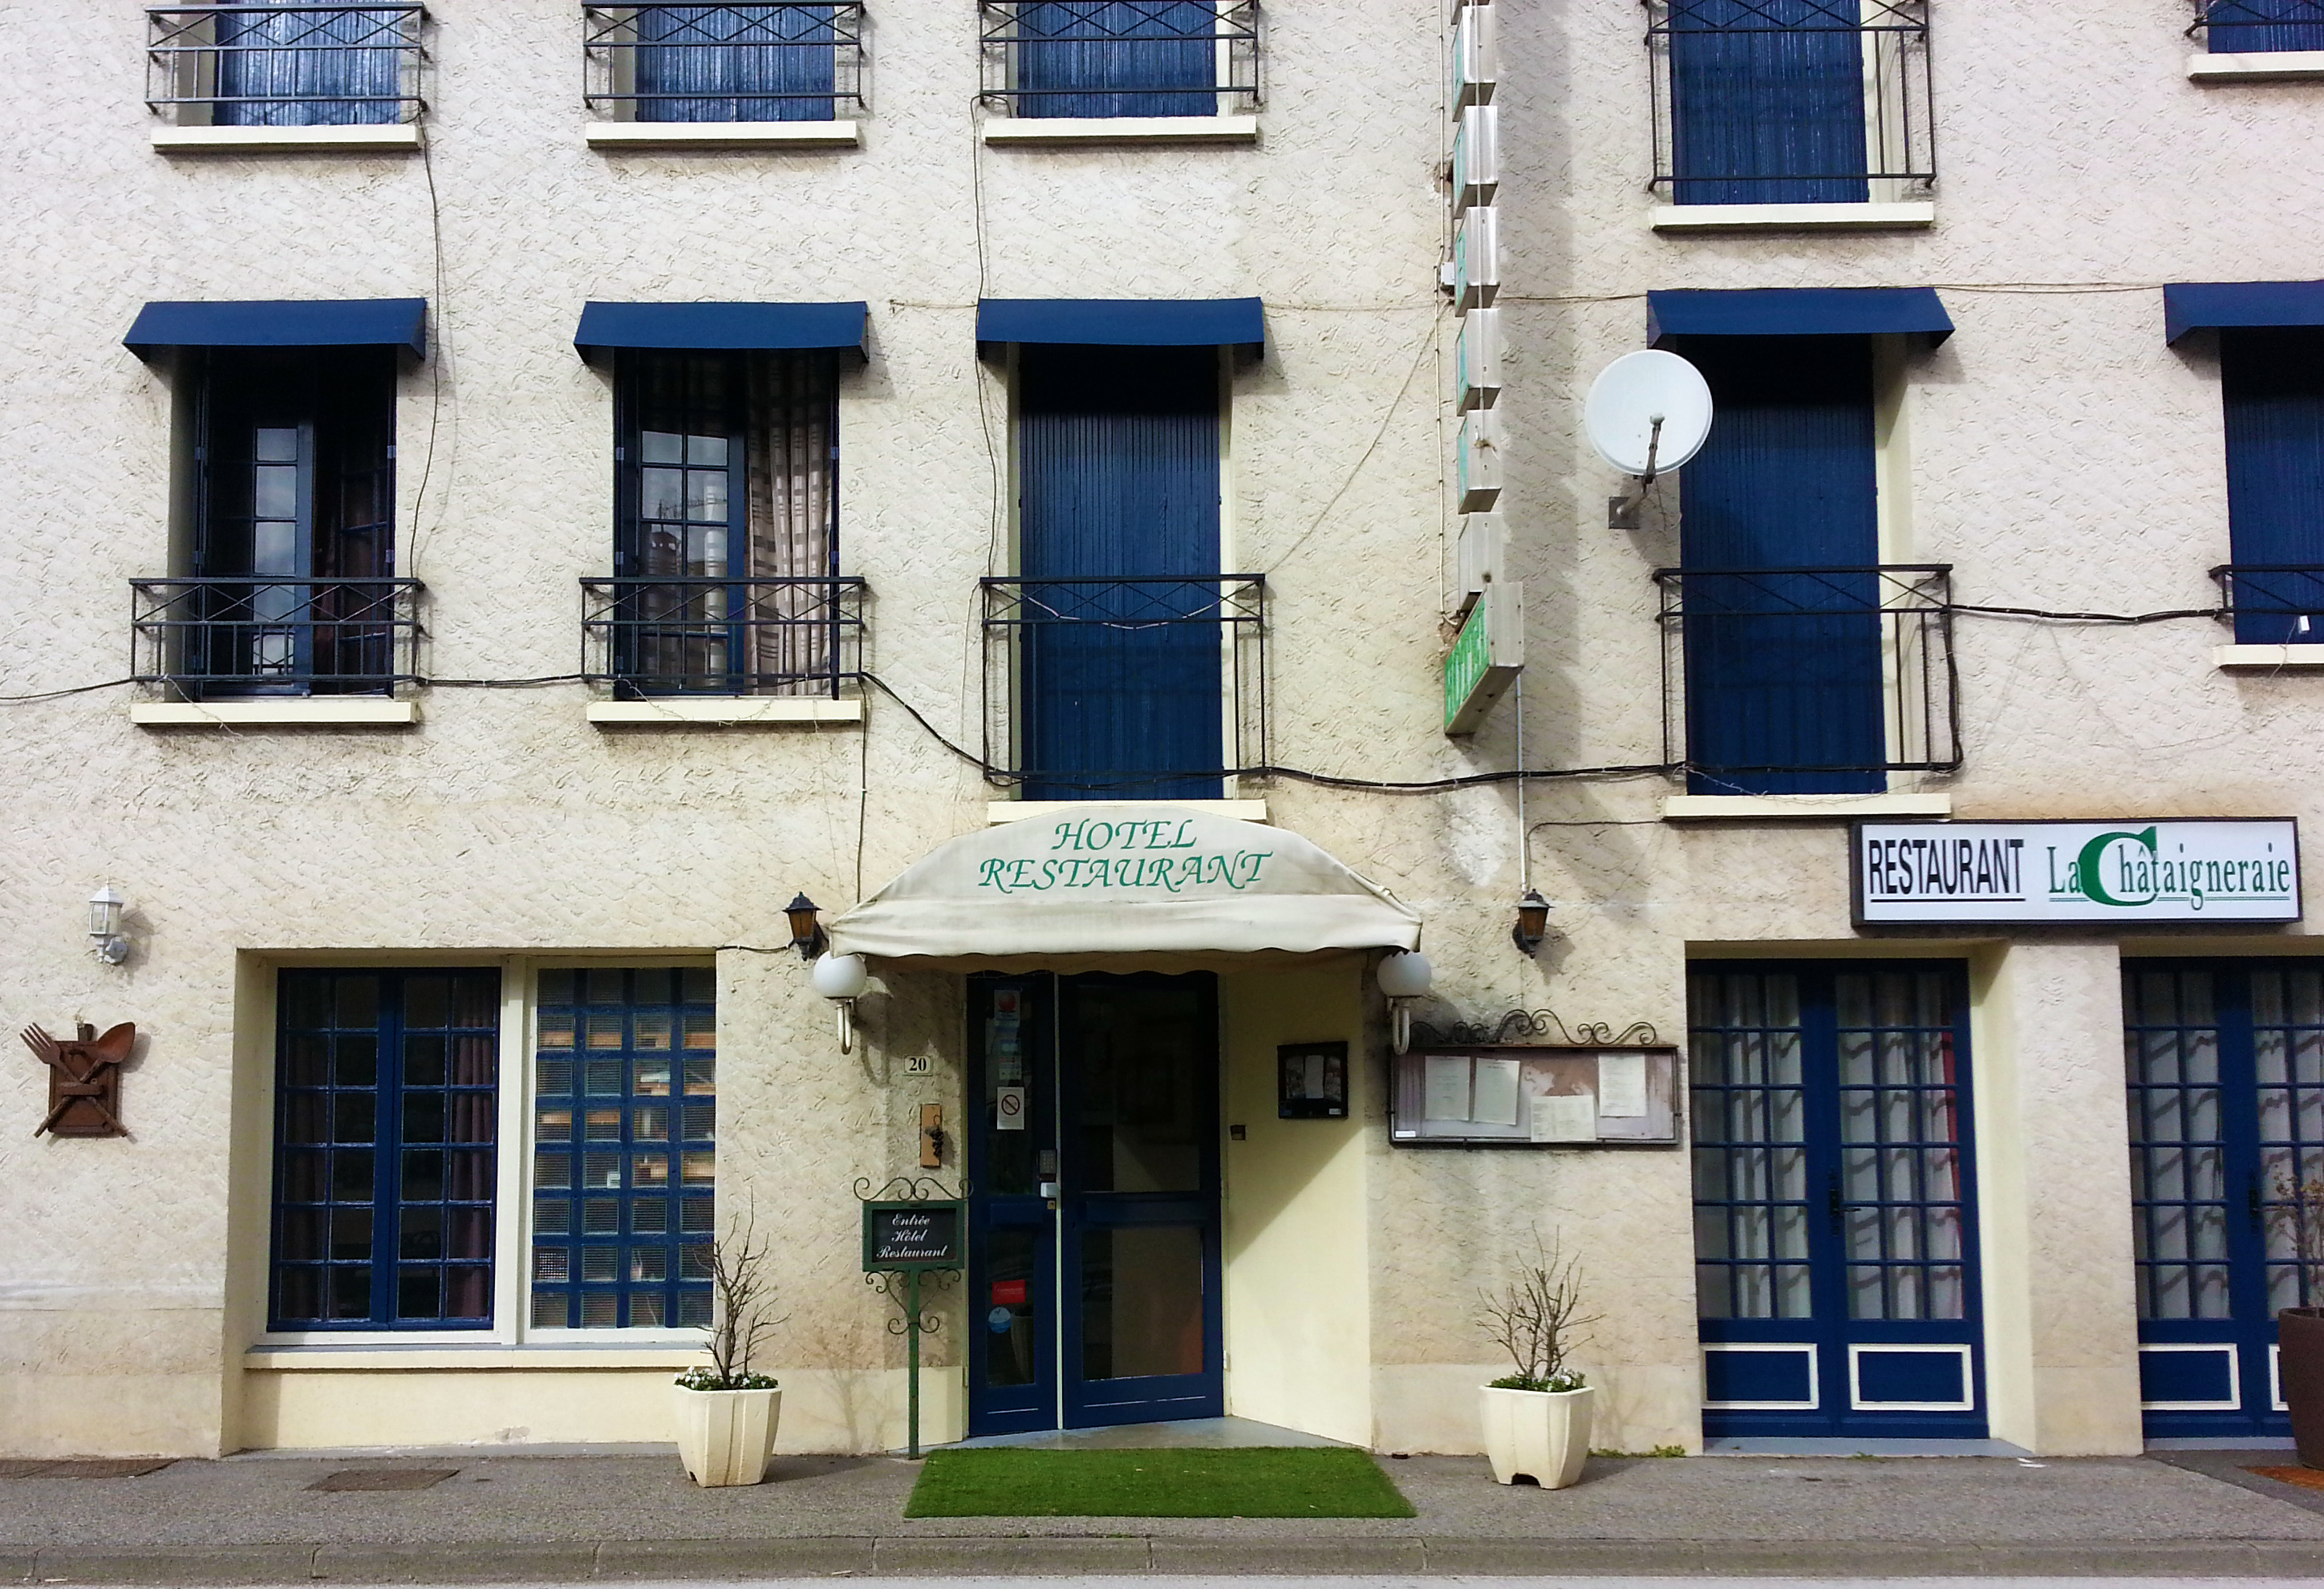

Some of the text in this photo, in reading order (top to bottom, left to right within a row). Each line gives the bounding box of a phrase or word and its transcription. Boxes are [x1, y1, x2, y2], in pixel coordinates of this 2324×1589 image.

[1052, 818, 1198, 850] HOTEL
[978, 850, 1273, 894] RESTAURANT
[1870, 826, 2290, 910] RESTAURANT La Châtaigneraie
[909, 1057, 927, 1072] 20
[892, 1213, 930, 1226] Entrée
[876, 1245, 947, 1258] Restaurant
